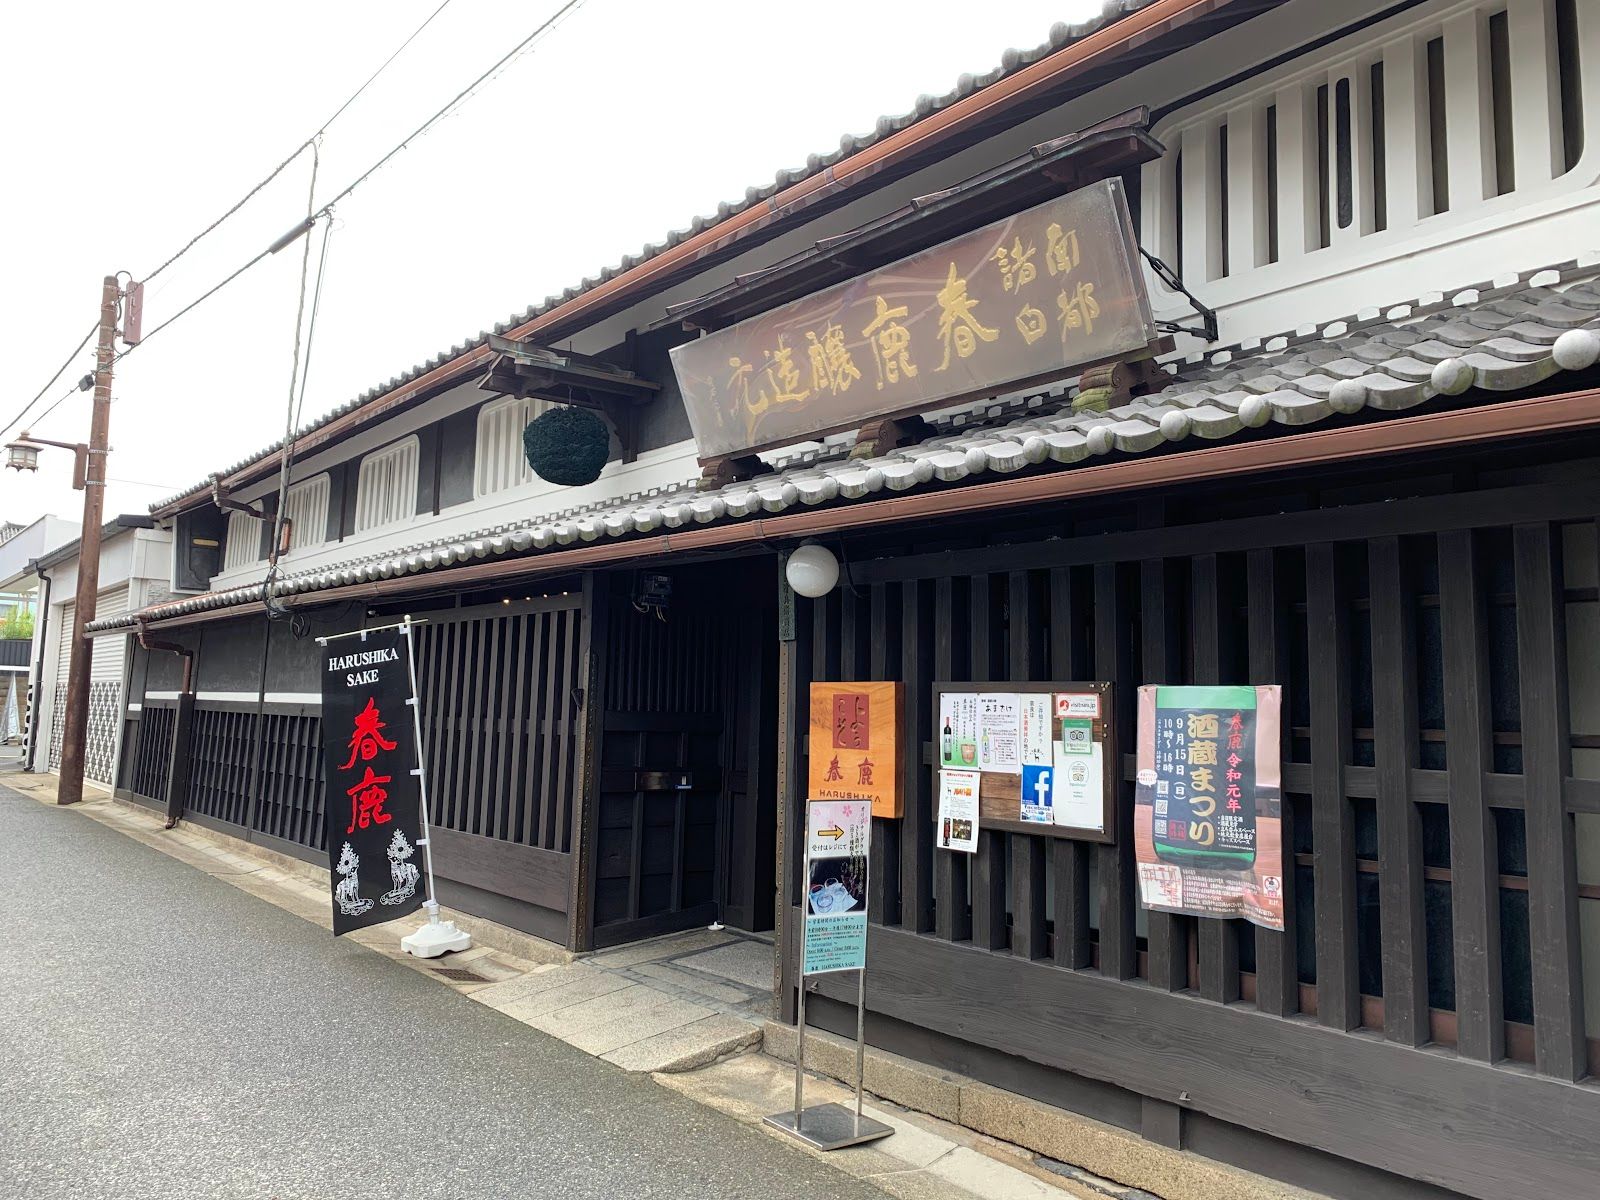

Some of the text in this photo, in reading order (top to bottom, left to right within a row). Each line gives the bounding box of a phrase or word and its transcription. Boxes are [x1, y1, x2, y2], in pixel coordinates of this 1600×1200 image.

[328, 647, 400, 672] HARUSHIKA
[346, 669, 380, 688] SAKE
[337, 696, 398, 835] 春鹿
[823, 754, 874, 786] 春鹿
[1187, 713, 1220, 847] 酒蔵まつり
[1225, 752, 1244, 814] 令和元年
[811, 843, 848, 853] 受付はレジにて
